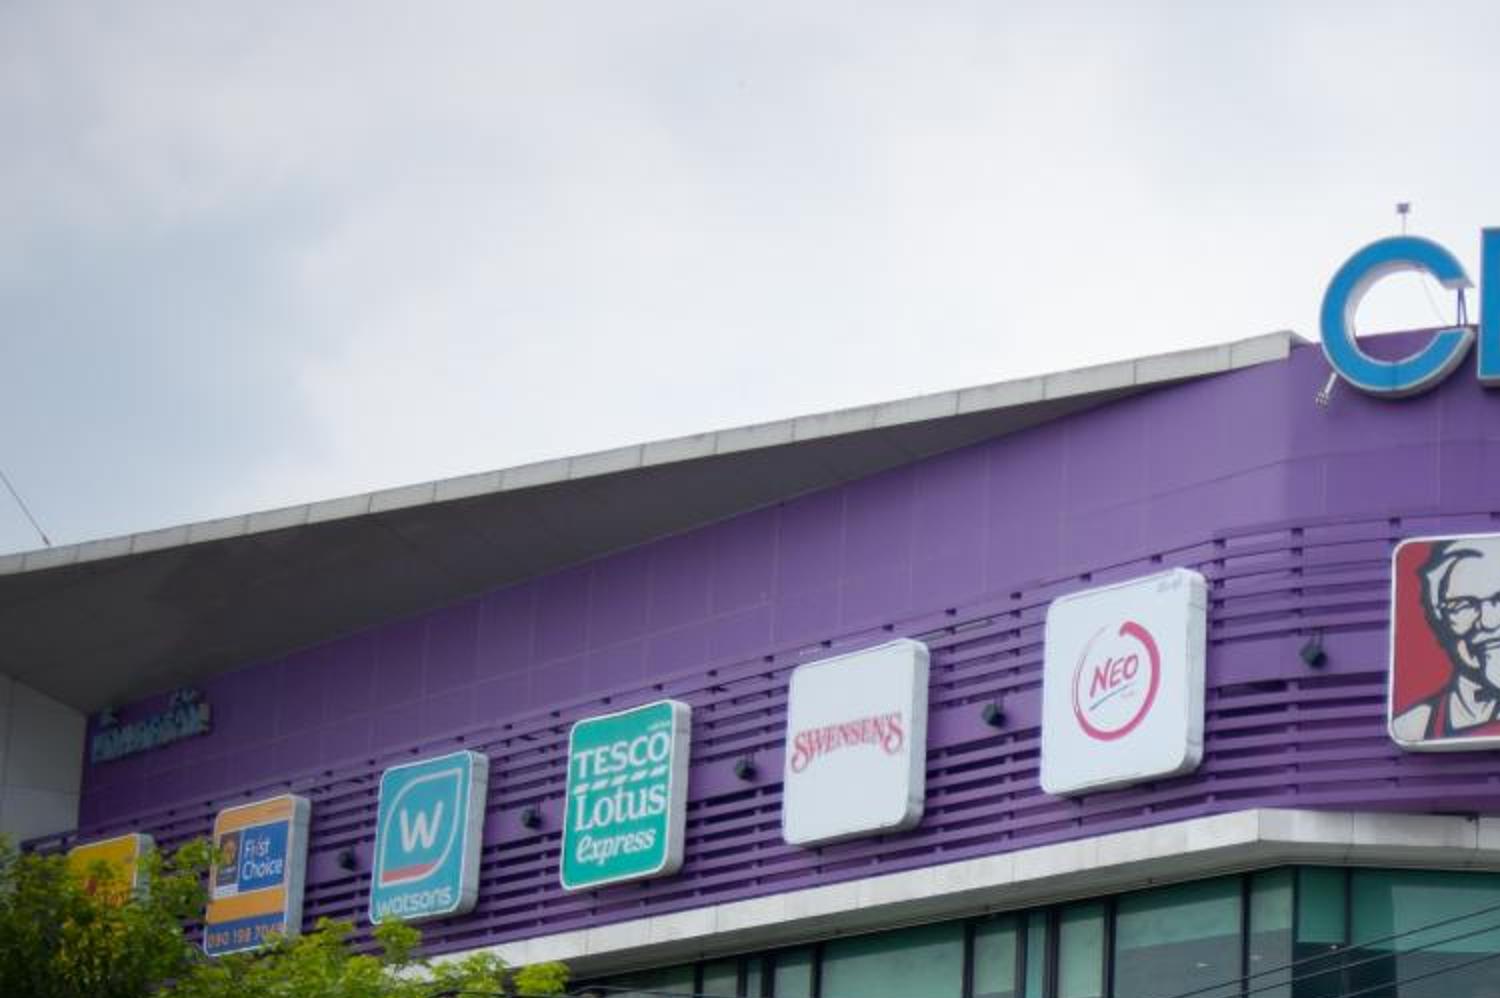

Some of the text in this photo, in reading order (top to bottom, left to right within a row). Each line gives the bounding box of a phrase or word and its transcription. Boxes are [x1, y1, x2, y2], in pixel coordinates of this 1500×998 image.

[1089, 653, 1139, 699] NEO
[572, 730, 671, 781] TESCO
[790, 711, 905, 774] SWENSEN'S
[400, 800, 445, 853] W
[575, 782, 667, 832] Lotus
[241, 857, 283, 881] Choice
[575, 829, 657, 866] express
